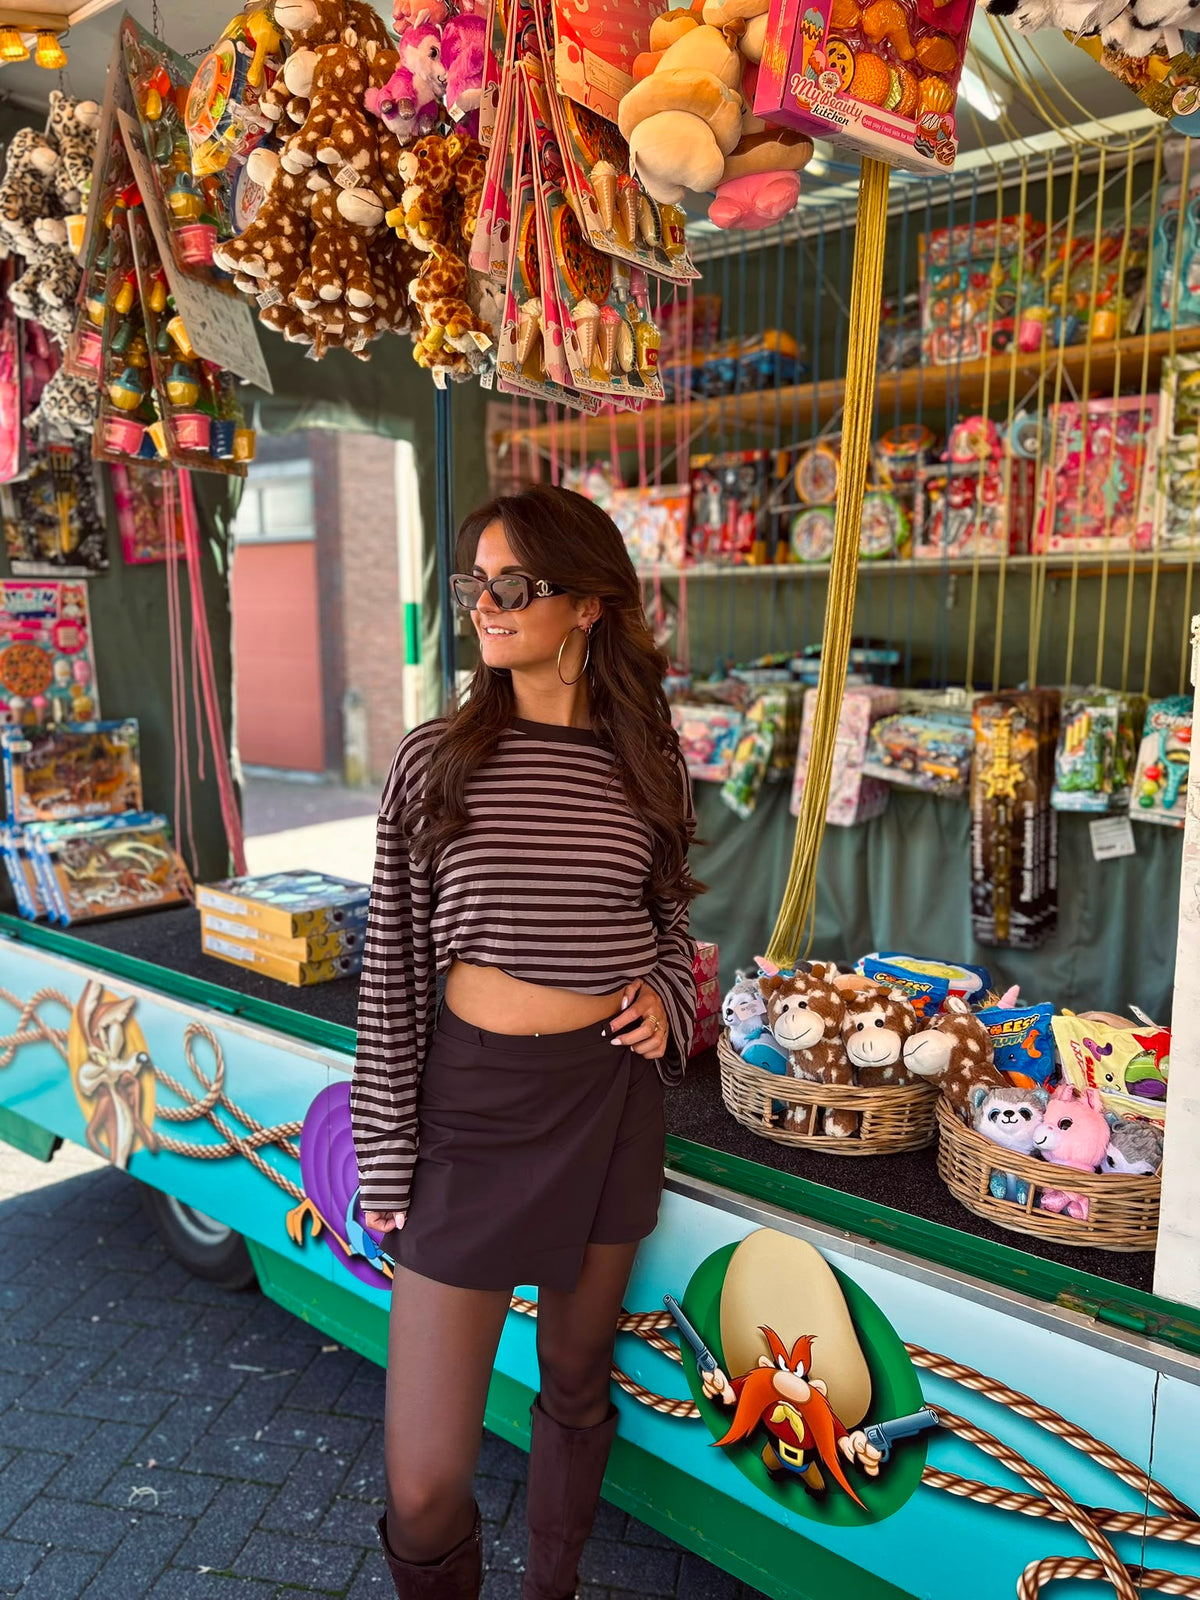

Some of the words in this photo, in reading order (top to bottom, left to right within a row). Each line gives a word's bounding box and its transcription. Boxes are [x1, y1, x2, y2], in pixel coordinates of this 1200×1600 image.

[791, 75, 822, 106] My
[820, 91, 863, 122] Beauty
[811, 103, 849, 127] kitchen
